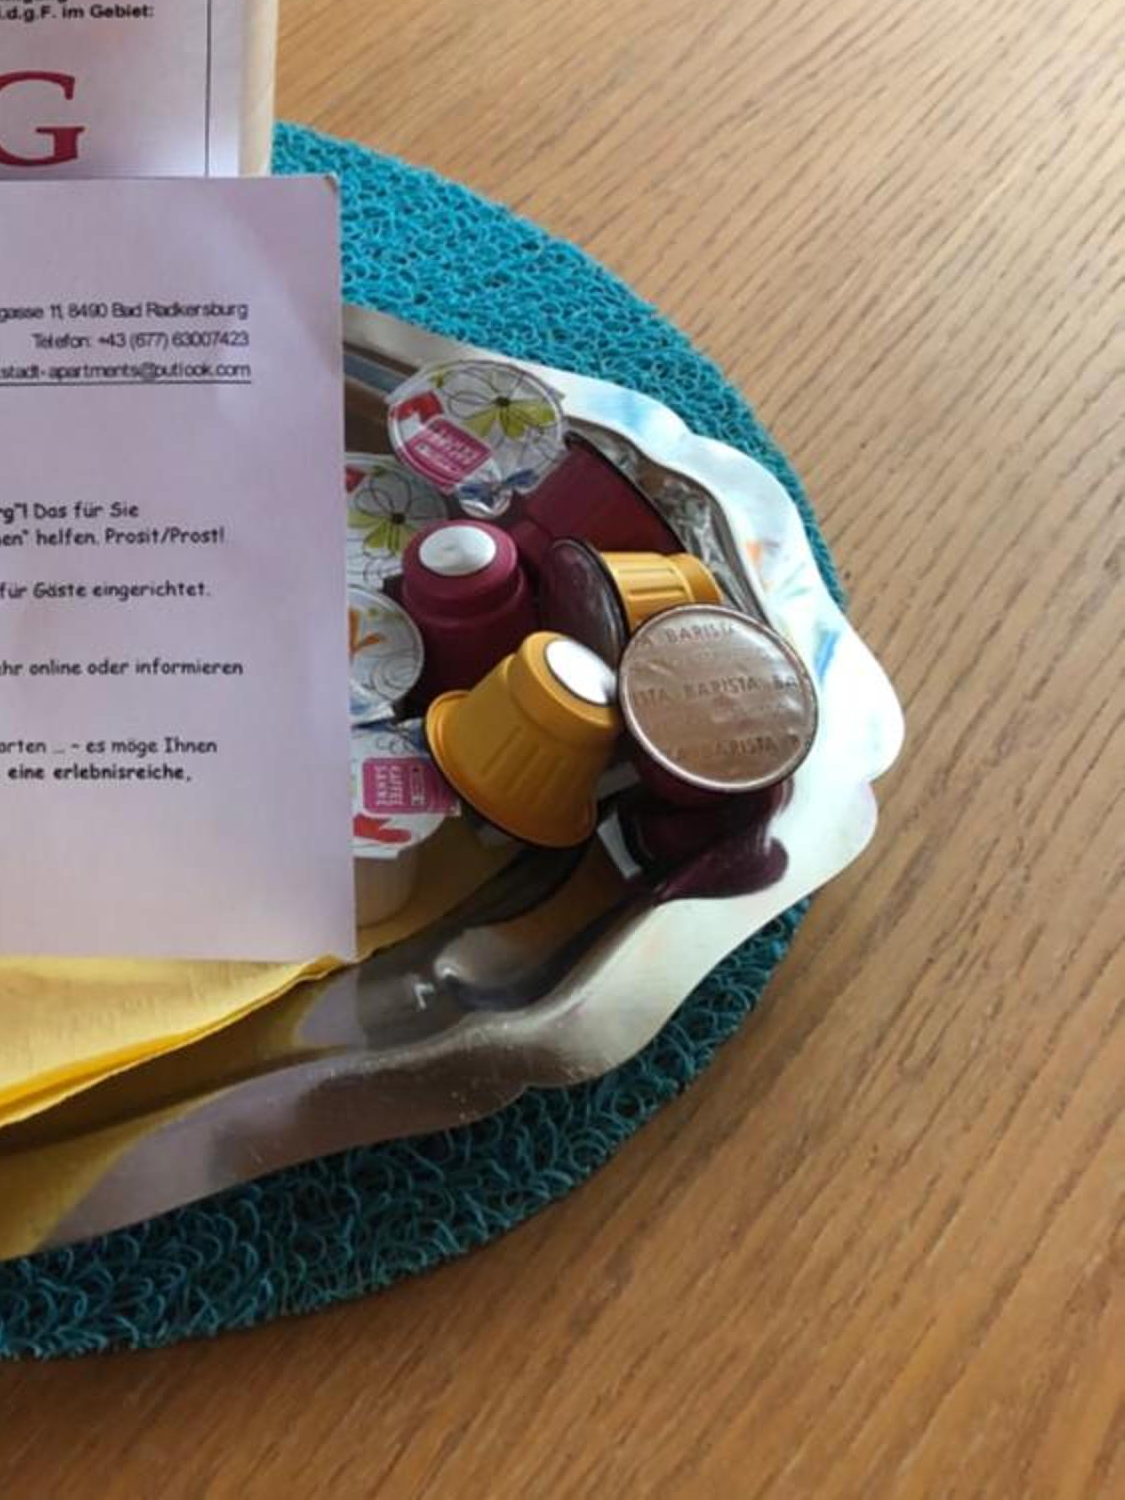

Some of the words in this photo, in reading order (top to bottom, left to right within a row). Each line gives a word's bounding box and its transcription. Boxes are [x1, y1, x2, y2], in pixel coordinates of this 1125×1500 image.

[61, 3, 86, 20] im
[89, 2, 154, 20] Gebiet:
[33, 502, 67, 520] Das
[73, 501, 103, 519] für
[110, 501, 139, 518] Sie
[35, 527, 100, 547] helfen.
[104, 526, 225, 545] Prosit/Prost!
[32, 581, 87, 600] Gäste
[91, 579, 211, 603] eingerichtet.
[28, 659, 82, 676] online
[86, 657, 130, 676] oder
[135, 656, 244, 676] informieren
[683, 674, 758, 699] BARISTA
[85, 740, 106, 755] es
[111, 739, 158, 759] möge
[164, 736, 218, 754] Ihnen
[7, 763, 45, 781] eine
[52, 762, 191, 782] erlebnisreiche,
